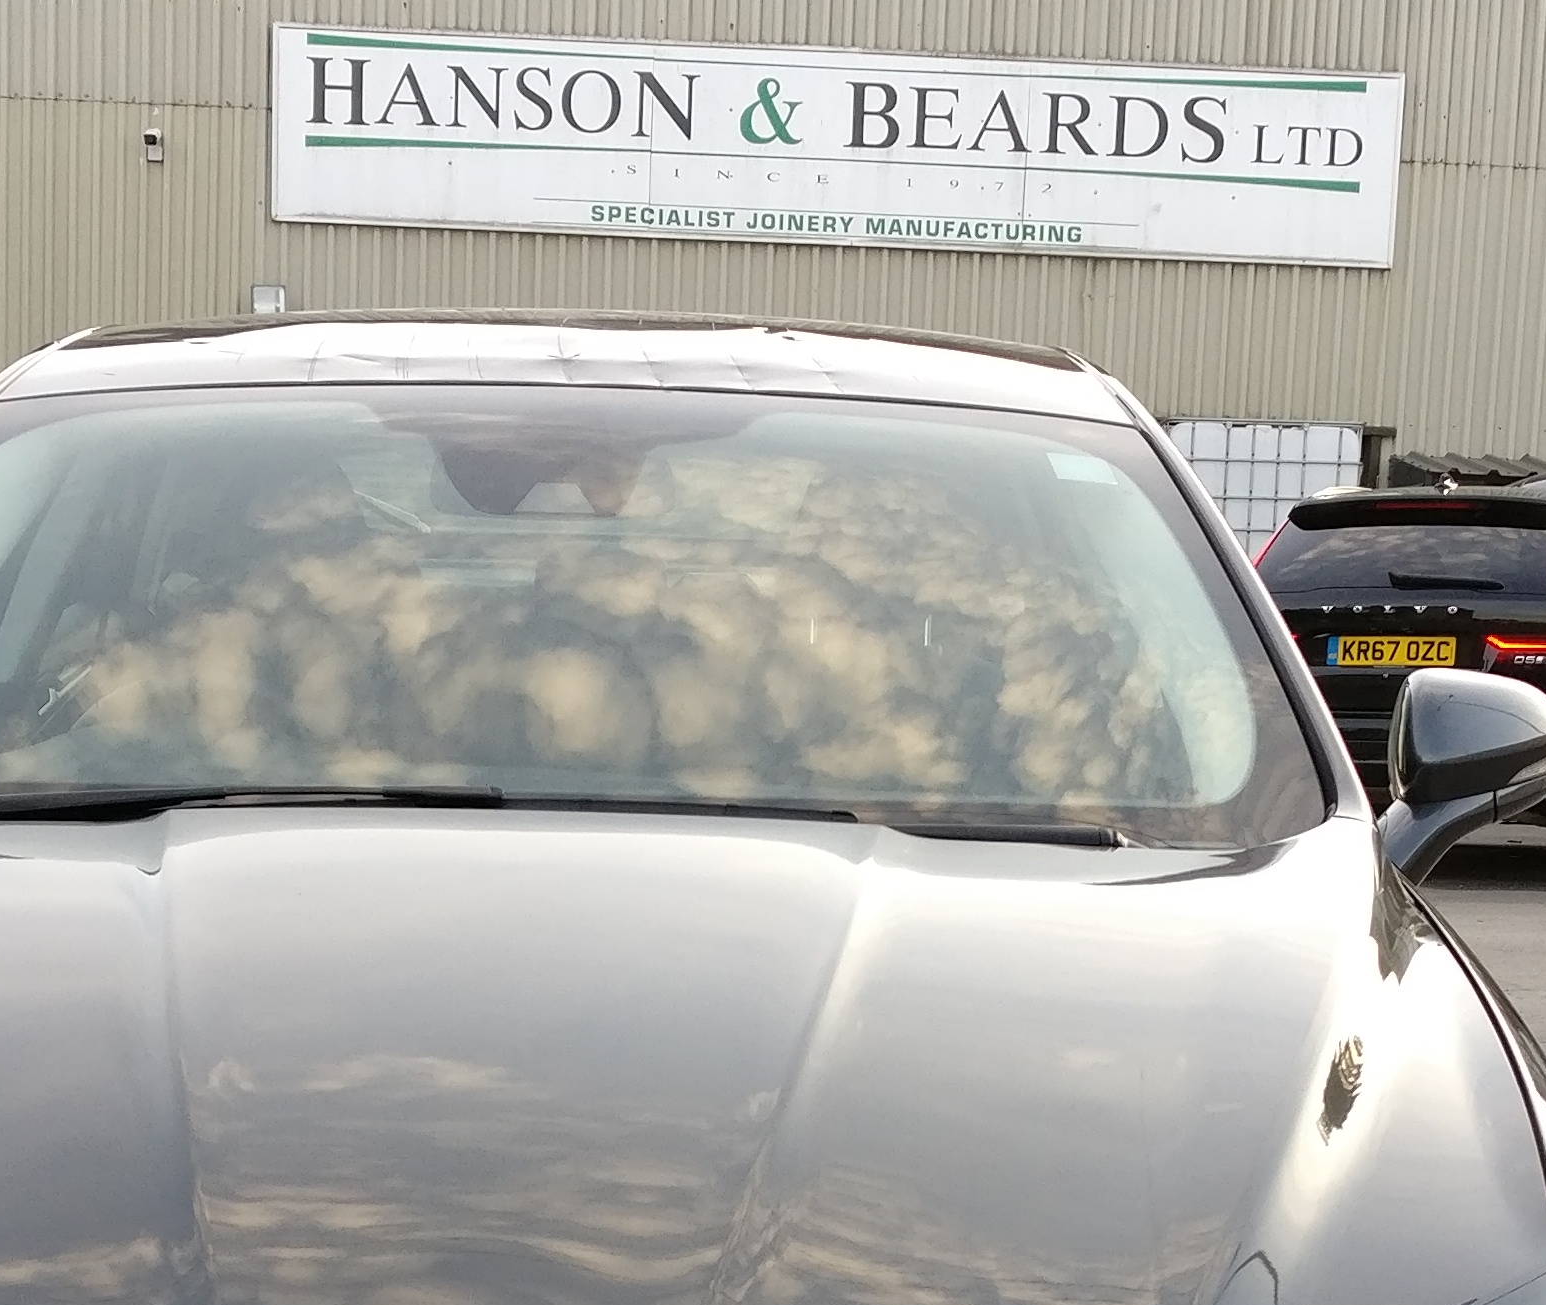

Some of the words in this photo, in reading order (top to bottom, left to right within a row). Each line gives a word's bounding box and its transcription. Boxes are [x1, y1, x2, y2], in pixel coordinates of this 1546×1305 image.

[304, 56, 701, 141] HANSON
[739, 77, 804, 145] &
[842, 80, 1230, 164] BEARDS
[1249, 123, 1364, 168] LTD
[626, 164, 830, 185] SINCE
[590, 205, 736, 229] SPECIALIST
[746, 211, 855, 235] JOINERY
[864, 217, 1084, 244] MANUFACTURING
[1320, 605, 1459, 615] VOLVO
[1342, 640, 1401, 662] KR67
[1406, 640, 1451, 662] OZC
